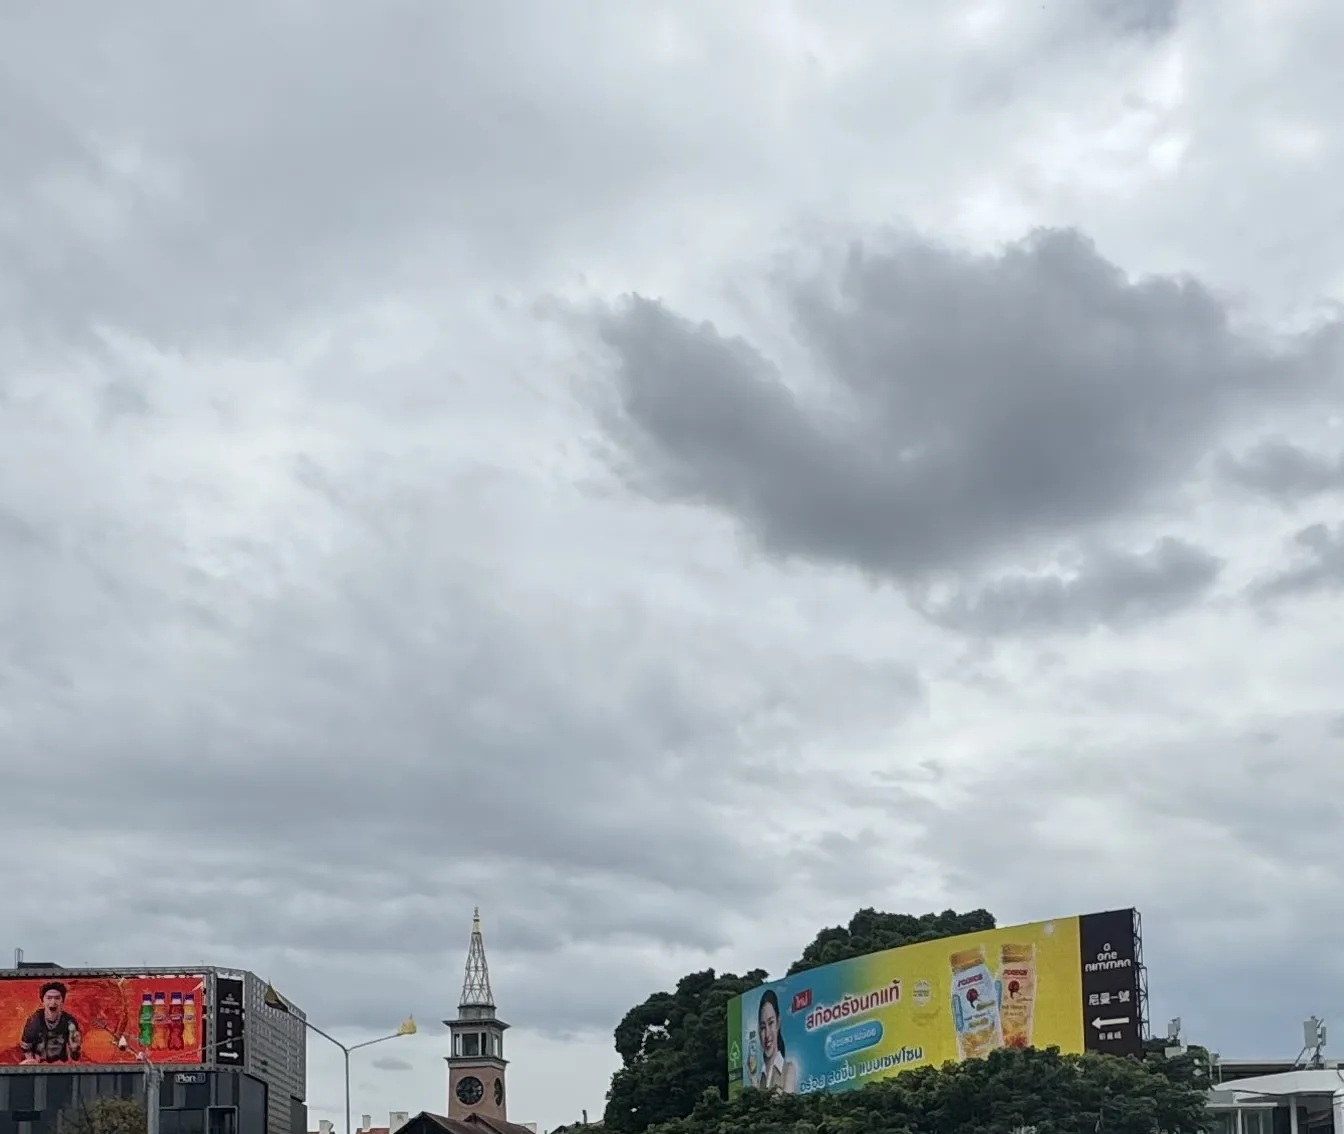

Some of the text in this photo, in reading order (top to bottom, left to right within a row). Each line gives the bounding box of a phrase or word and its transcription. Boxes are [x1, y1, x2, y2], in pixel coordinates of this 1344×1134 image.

[1097, 951, 1118, 961] one
[806, 980, 901, 1030] สก๊อตรังนกแท้
